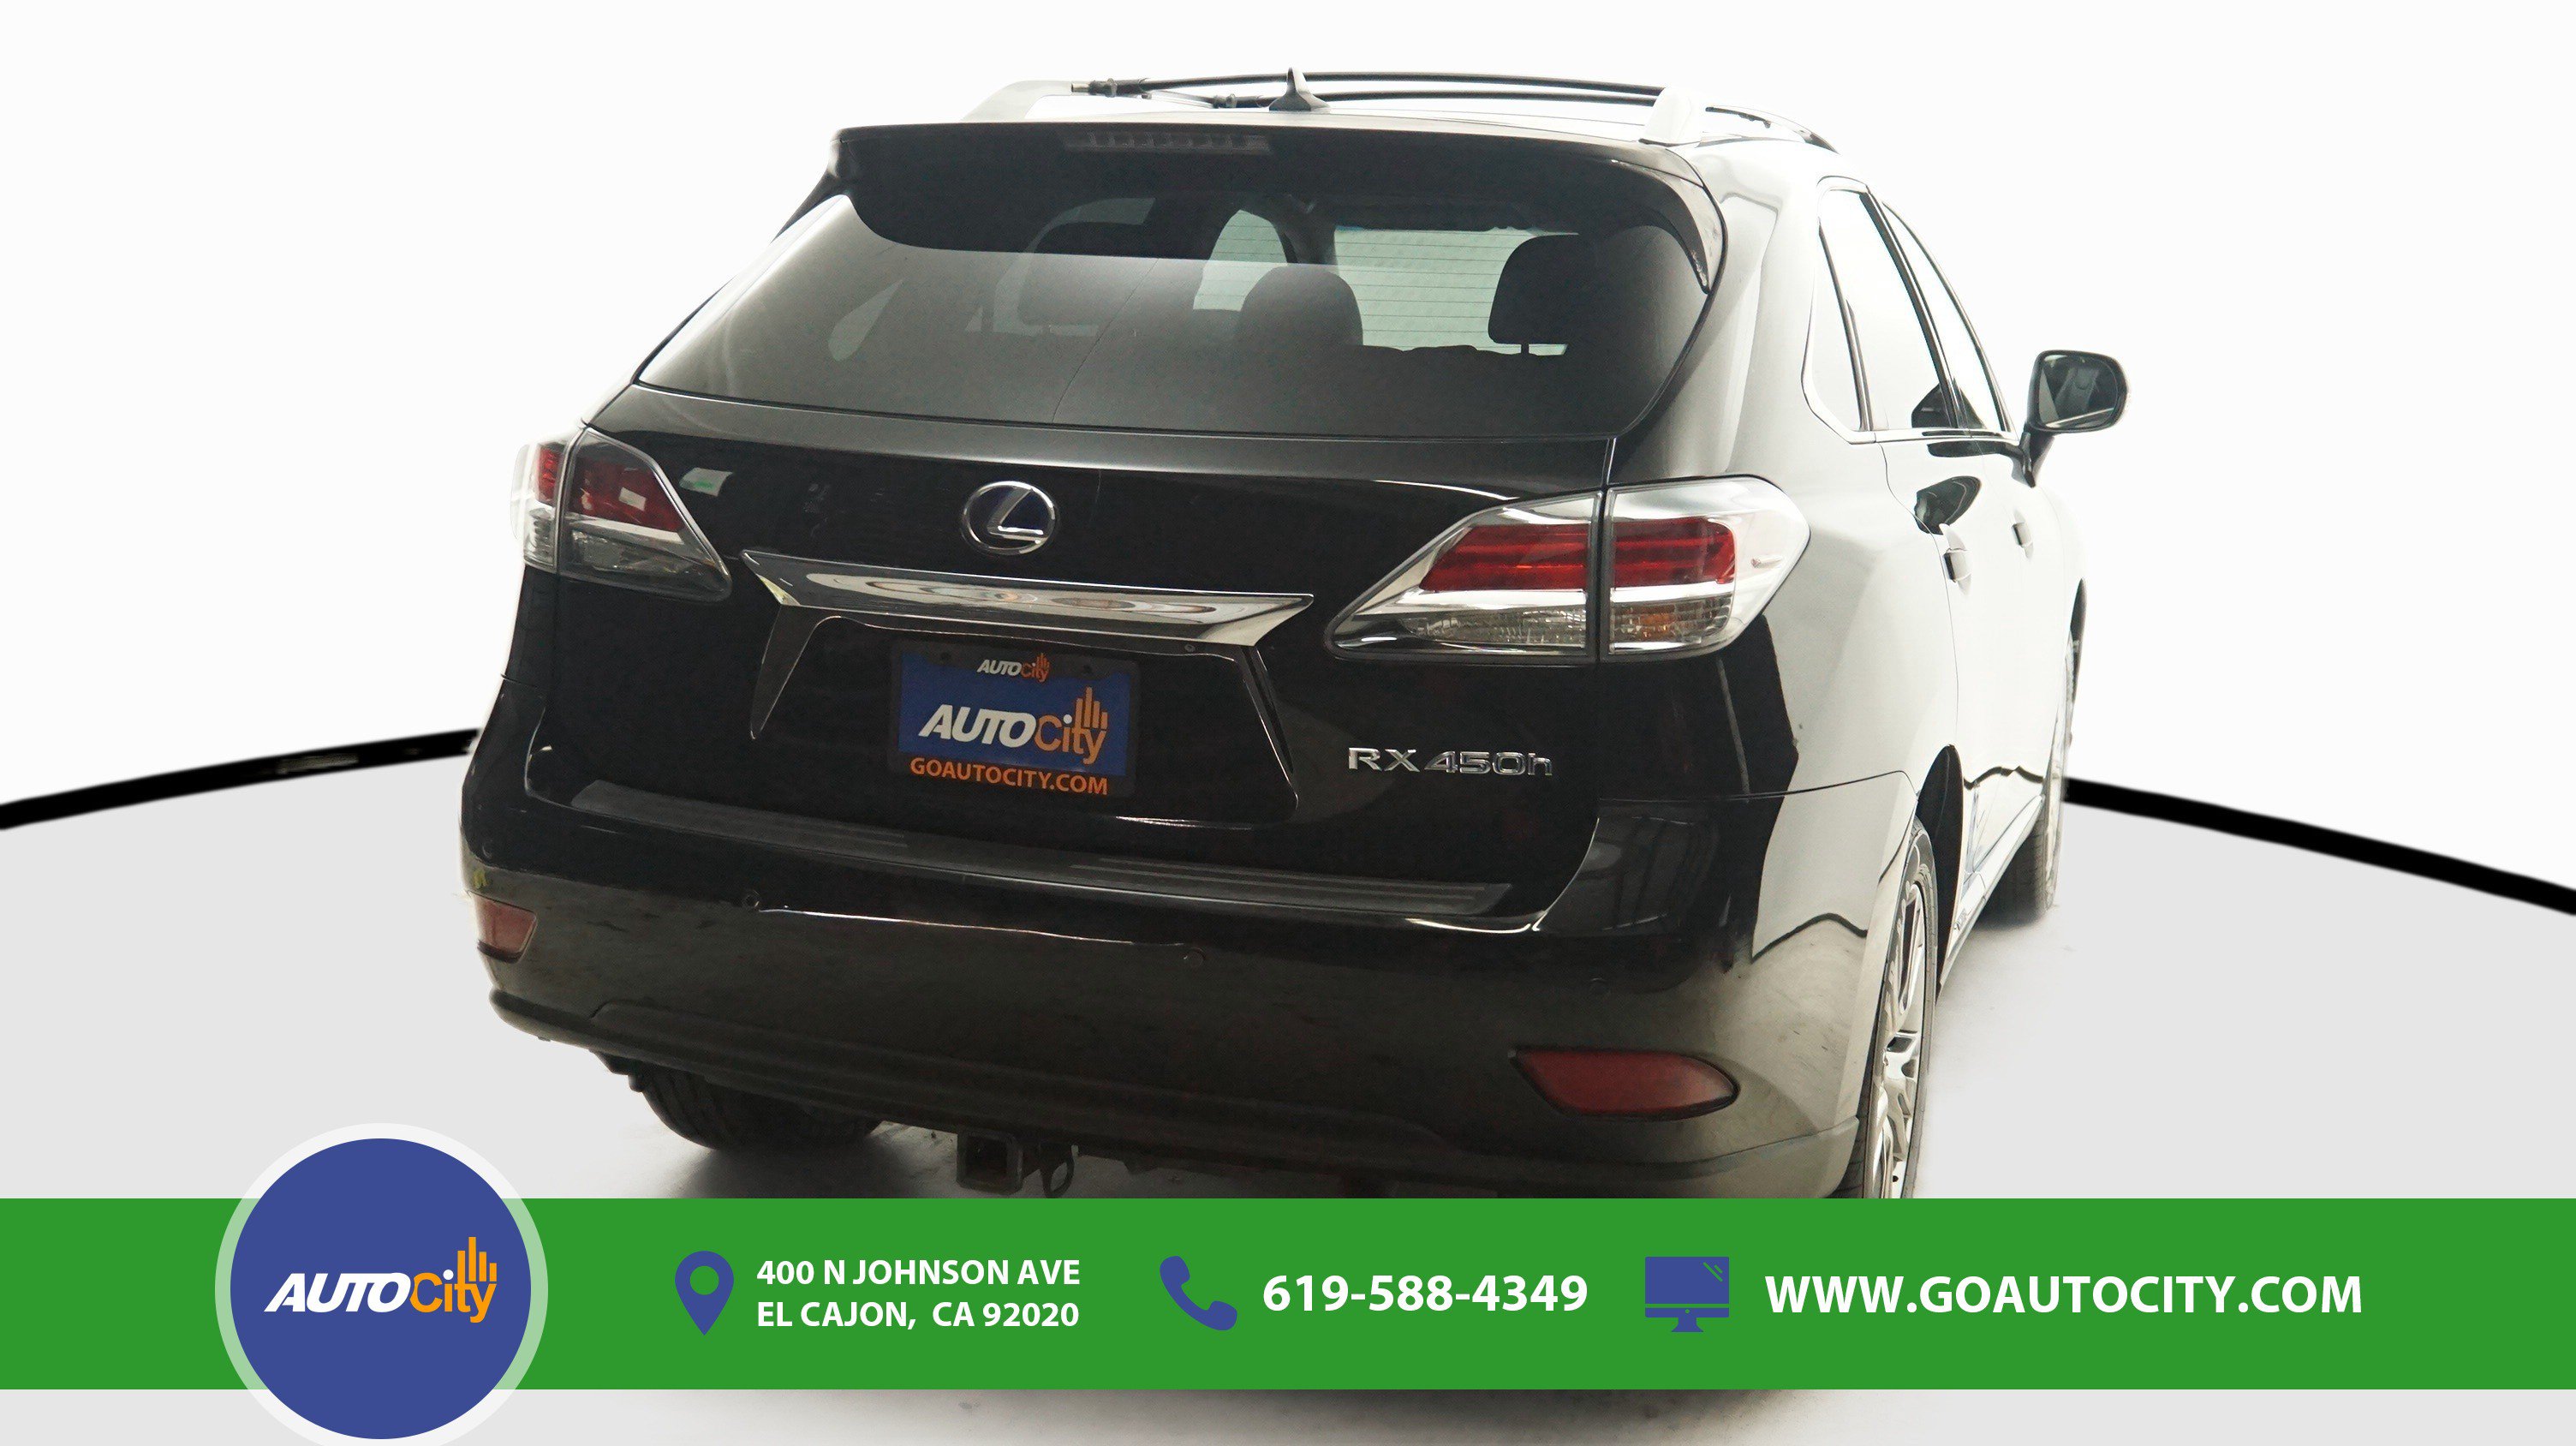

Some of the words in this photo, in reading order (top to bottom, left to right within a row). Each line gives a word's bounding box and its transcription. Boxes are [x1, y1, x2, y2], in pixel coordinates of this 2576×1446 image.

[909, 757, 1108, 795] GOAUTOCITY.COM
[1348, 747, 1420, 772] RX
[1424, 750, 1553, 776] 450h
